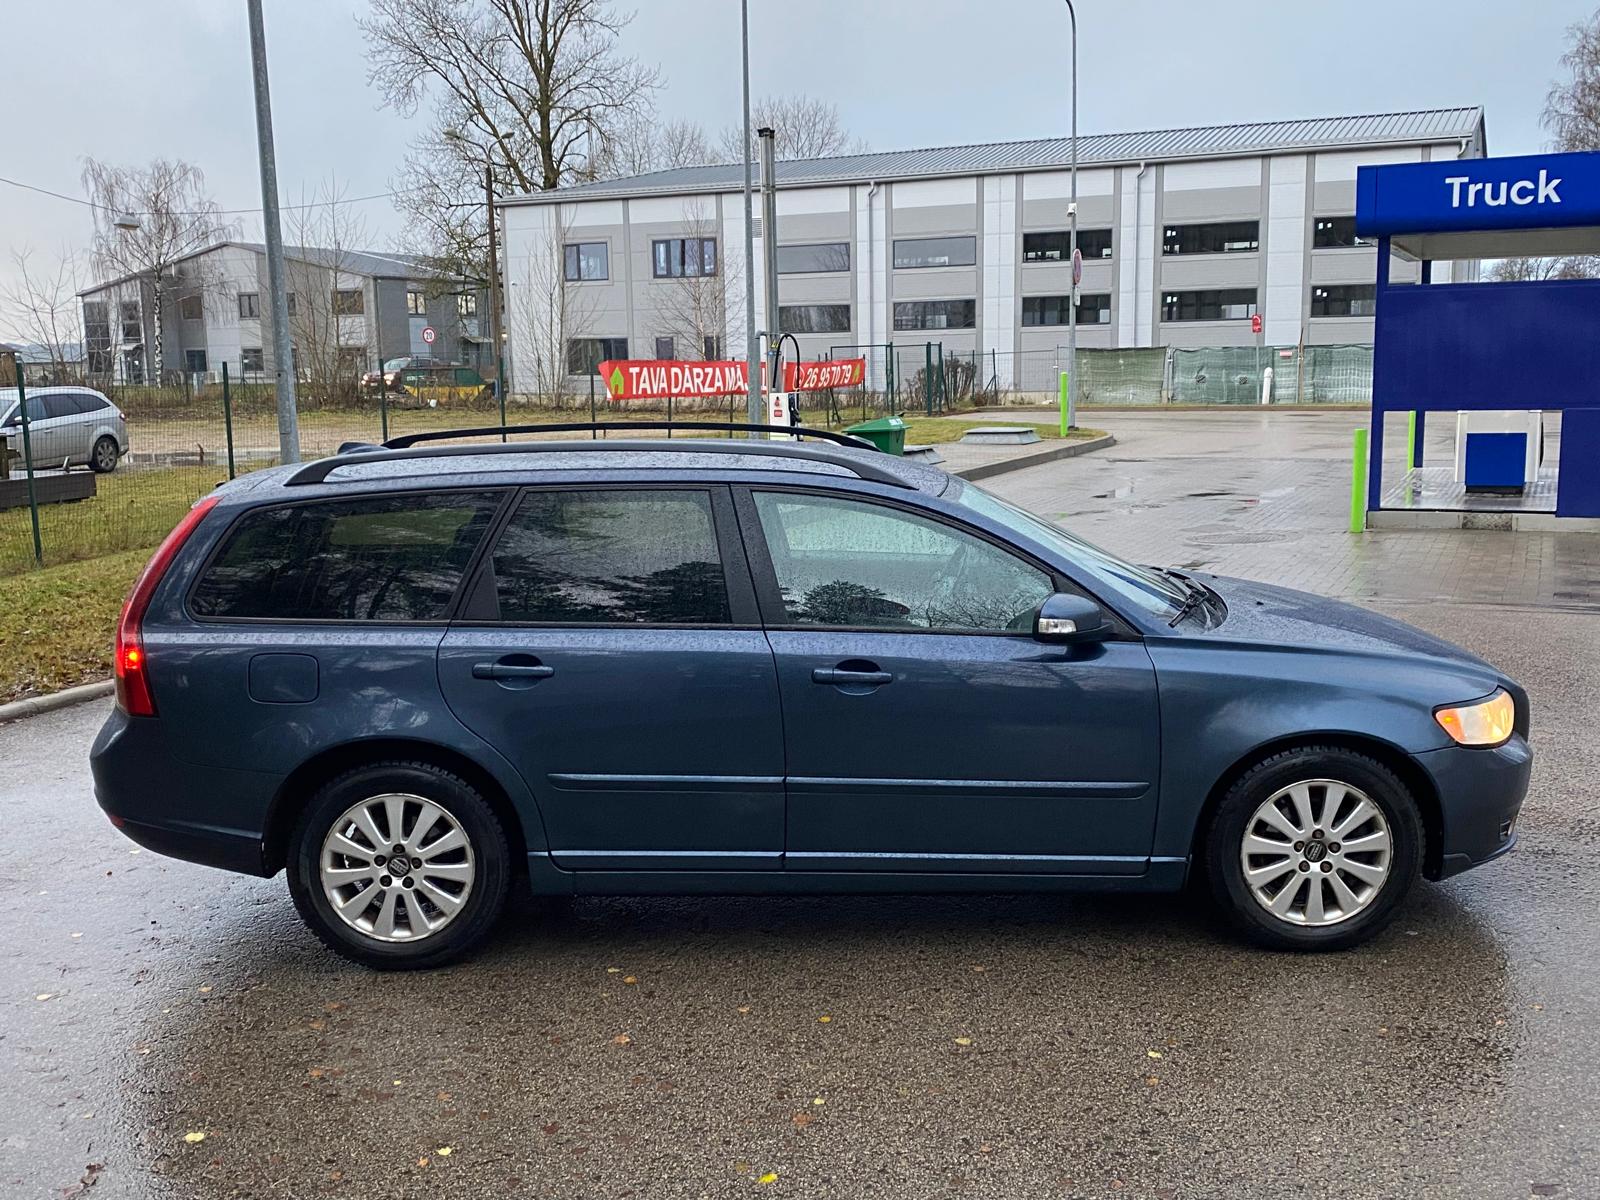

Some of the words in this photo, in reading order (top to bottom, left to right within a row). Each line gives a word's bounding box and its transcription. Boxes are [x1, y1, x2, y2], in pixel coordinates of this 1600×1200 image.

[1445, 169, 1562, 208] Truck
[425, 331, 433, 340] 20
[629, 366, 669, 395] TAVA
[670, 364, 724, 393] DĀRZA
[803, 367, 819, 388] 26
[818, 366, 831, 387] 95
[830, 365, 842, 386] 70
[840, 364, 853, 384] 79
